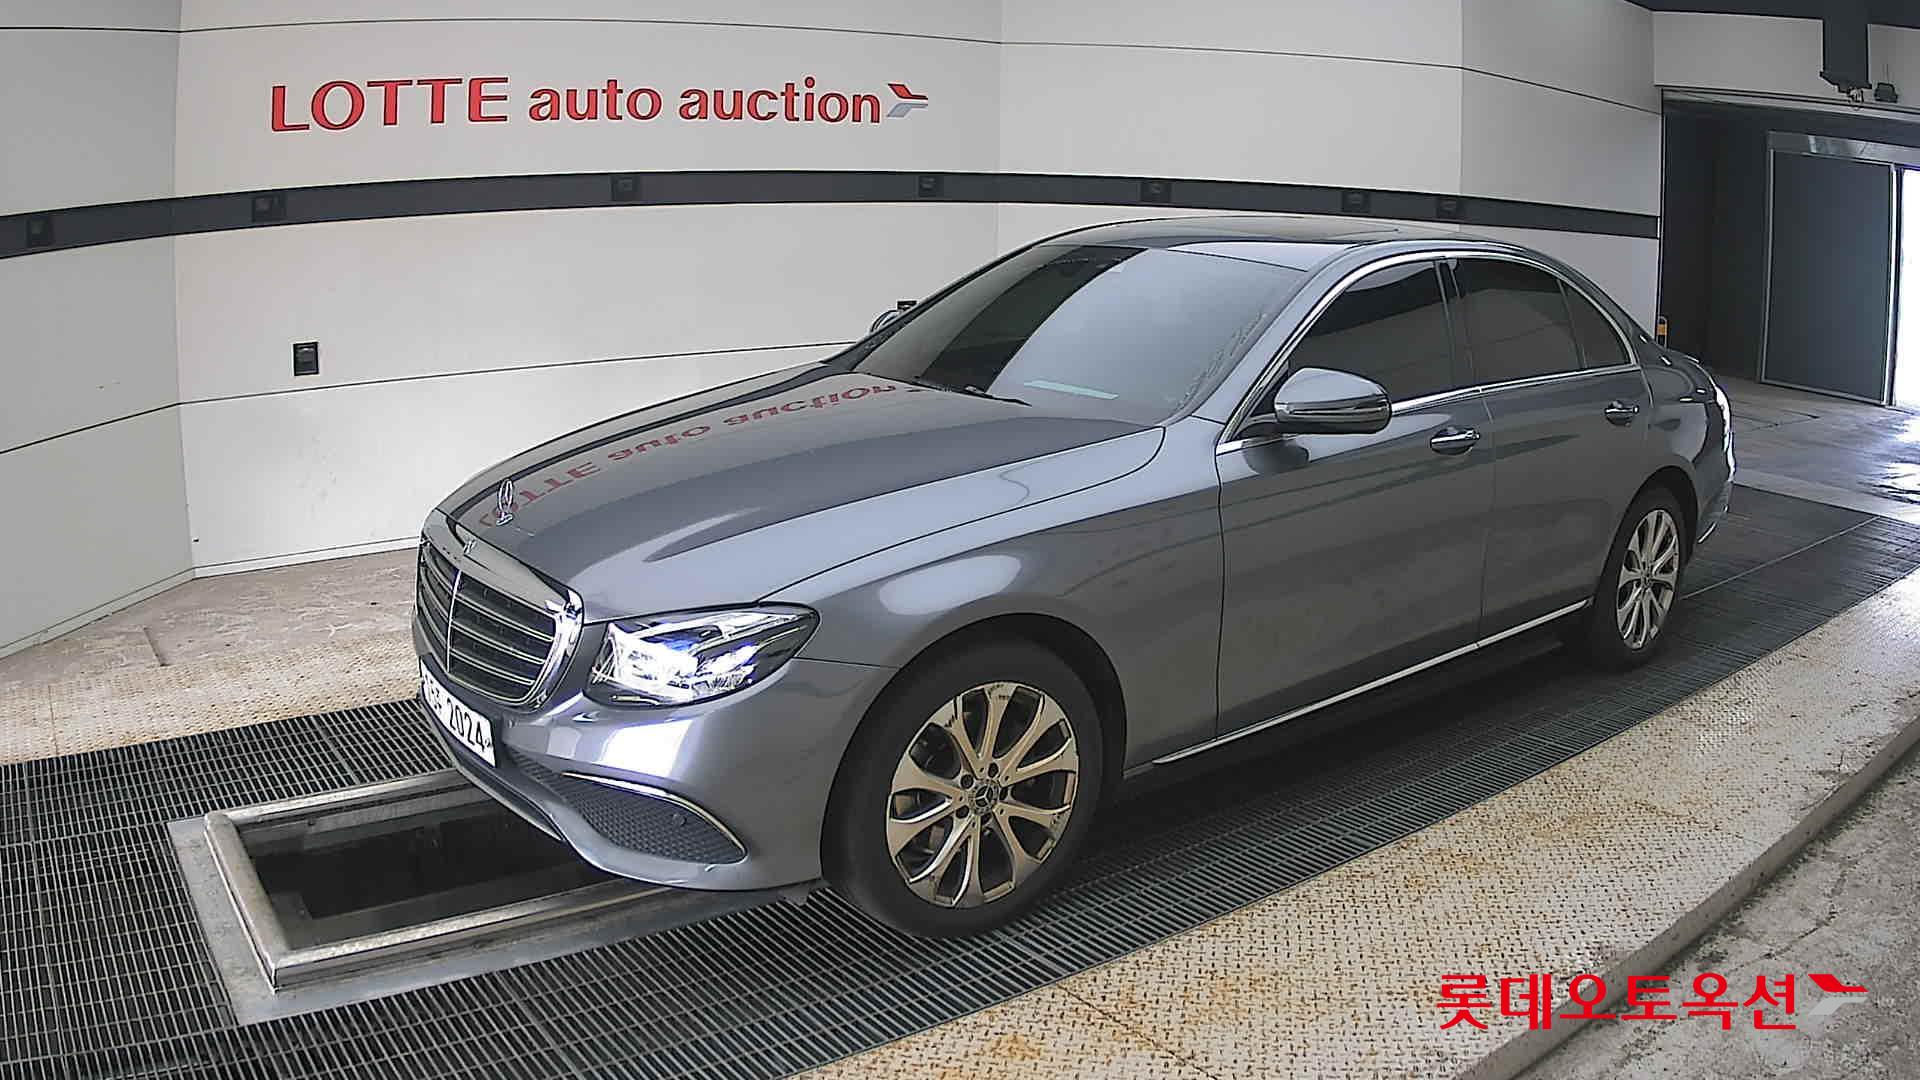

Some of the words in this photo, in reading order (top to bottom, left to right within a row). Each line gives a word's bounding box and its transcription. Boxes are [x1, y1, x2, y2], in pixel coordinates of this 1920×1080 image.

[271, 76, 509, 133] LOTTE
[527, 80, 663, 122] auto
[678, 76, 881, 124] auction
[446, 697, 486, 753] 2024
